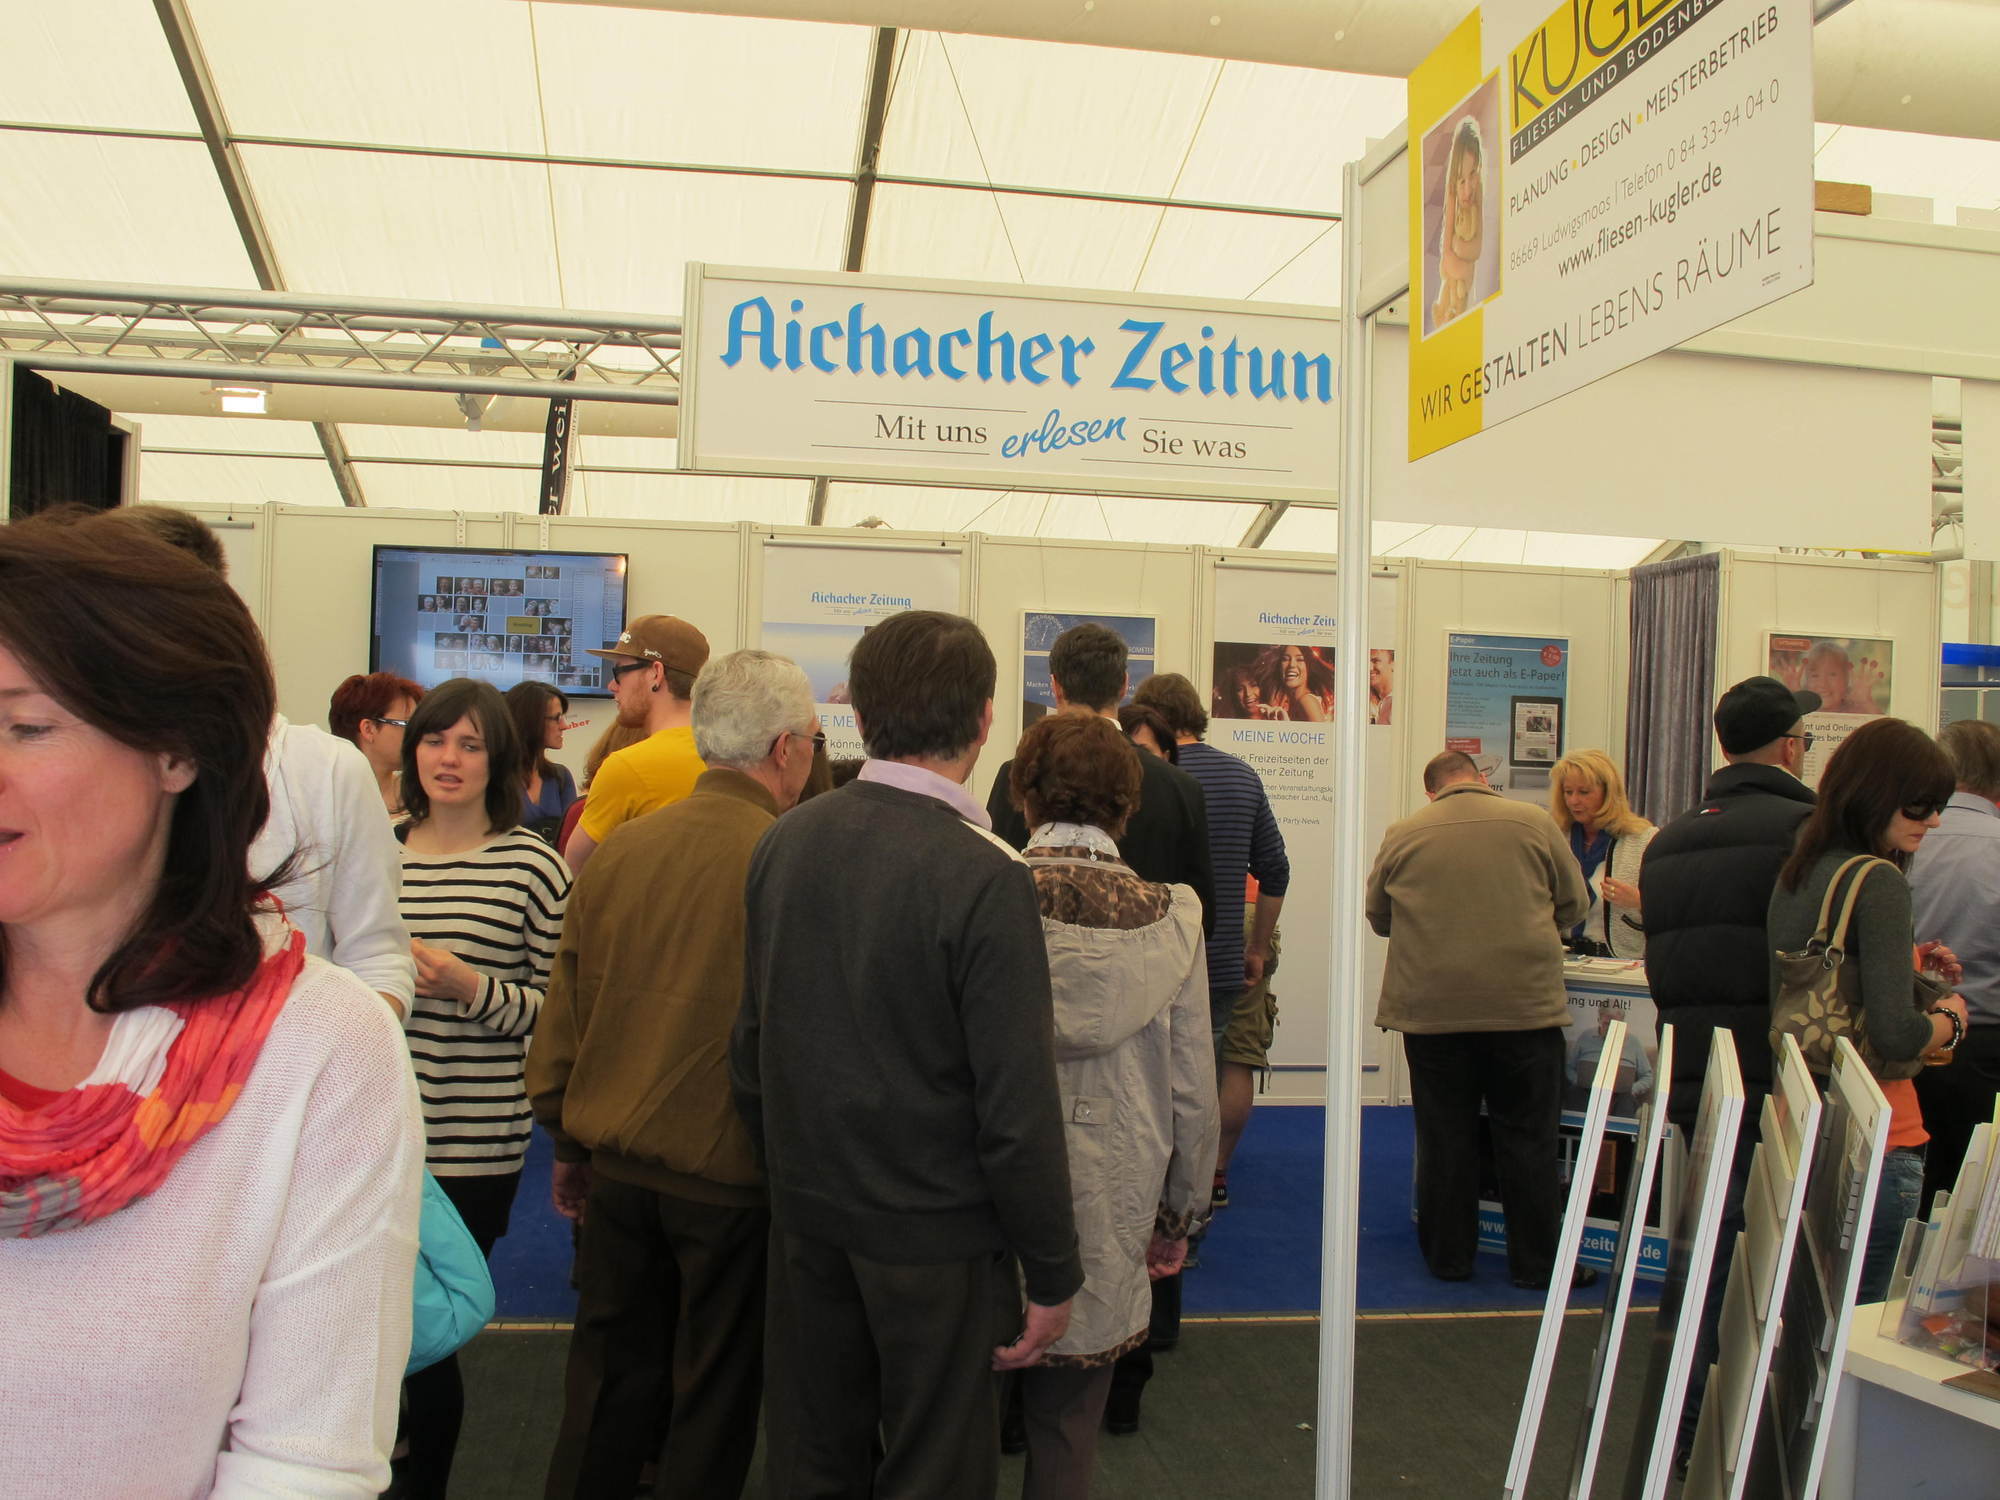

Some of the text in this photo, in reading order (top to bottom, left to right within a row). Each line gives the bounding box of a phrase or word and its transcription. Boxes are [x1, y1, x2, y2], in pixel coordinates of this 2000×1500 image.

[1509, 5, 1779, 218] PLANUNG DESIGN MEISTERBETRIEB
[1511, 102, 1575, 158] FLIESEN-
[1581, 64, 1617, 103] UND
[1509, 78, 1780, 271] 86669 Ludwigsmoos Telefon 0 84 33-94 04 0
[1557, 161, 1722, 278] www.fliesen-kugler.de
[1420, 207, 1782, 424] WIR GESTALTEN LEBENS RÄUME
[719, 295, 1340, 405] Aichacher Zeitun
[552, 399, 569, 475] wei
[874, 408, 1247, 459] Mit uns erlesen Sie was
[811, 591, 912, 609] Aichacher Zeitung
[1258, 611, 1311, 625] Aichacher
[1450, 651, 1513, 668] Ihre Zeitung
[1475, 666, 1500, 679] auch
[1503, 668, 1518, 680] als
[1520, 668, 1565, 683] E-Paper!
[833, 715, 856, 728] ME
[1815, 723, 1831, 731] und
[1232, 730, 1326, 745] MEINE WOCHE
[1826, 734, 1845, 742] betr
[1249, 753, 1311, 765] Freizeitseiten
[1313, 756, 1329, 766] der
[1256, 767, 1314, 780] cher Zeitung
[1588, 998, 1610, 1008] und
[1612, 1000, 1632, 1010] Alt!
